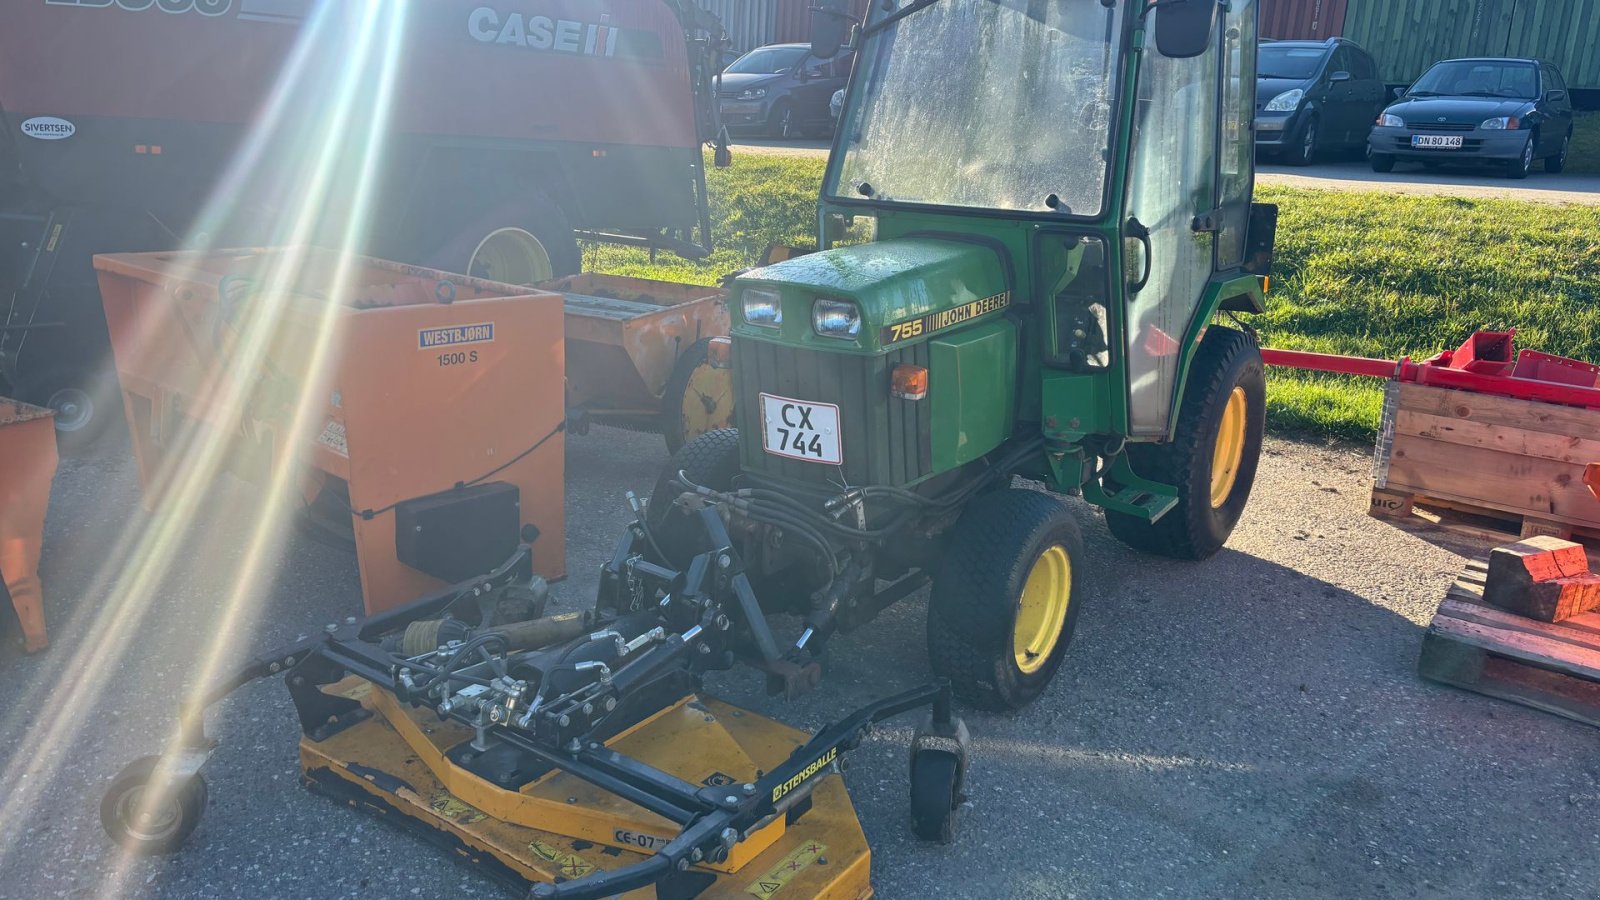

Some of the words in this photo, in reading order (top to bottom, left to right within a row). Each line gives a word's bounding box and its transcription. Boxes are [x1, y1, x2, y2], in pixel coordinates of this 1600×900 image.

[468, 7, 583, 52] CASE
[25, 123, 72, 133] SIVERTSEN
[1418, 136, 1430, 145] DN
[1431, 137, 1443, 146] 80
[1445, 137, 1461, 146] 148
[890, 319, 923, 342] 755
[943, 304, 972, 326] JOHN
[975, 292, 1006, 316] DEERE
[423, 325, 490, 346] WESTBJØRN
[437, 352, 466, 367] 1500
[469, 350, 478, 363] S
[781, 403, 814, 430] CX
[777, 427, 822, 457] 744
[782, 746, 837, 796] STENSBALLE
